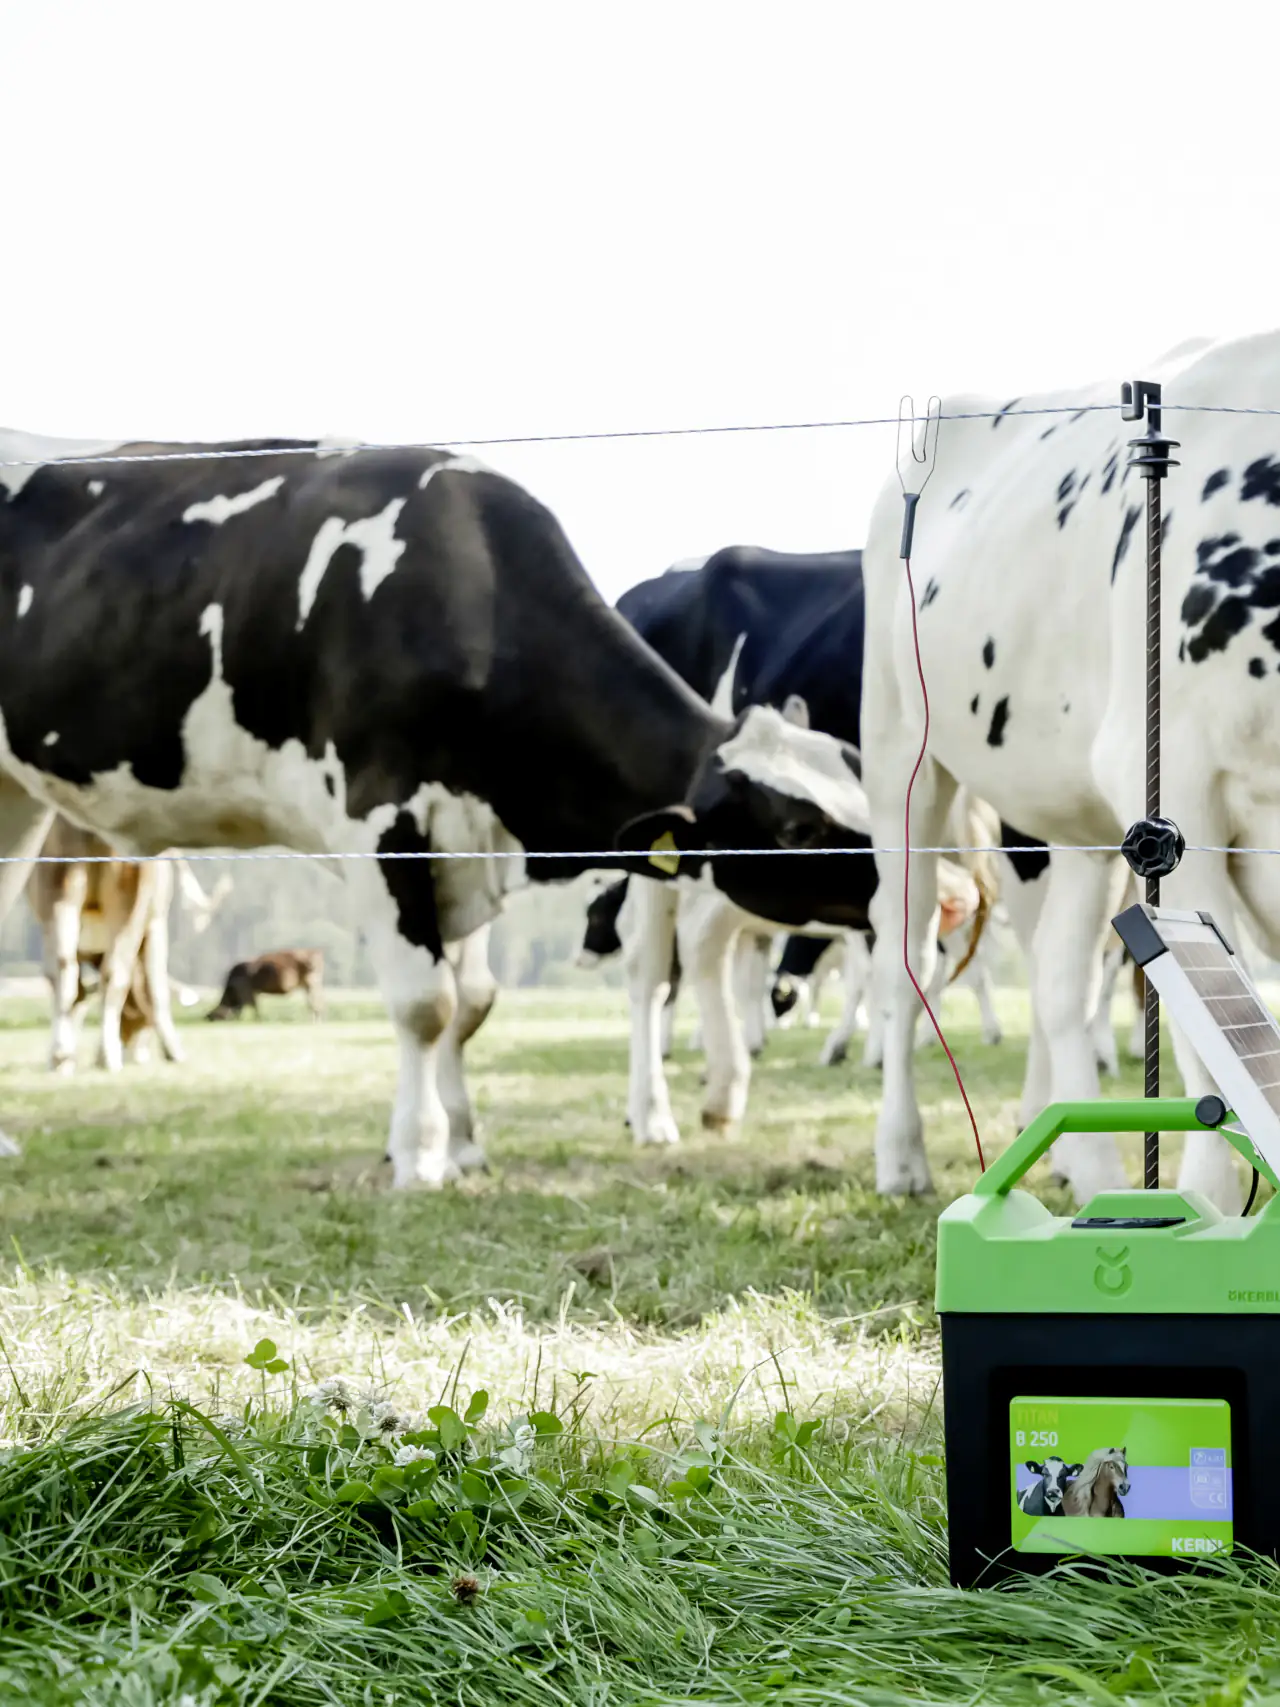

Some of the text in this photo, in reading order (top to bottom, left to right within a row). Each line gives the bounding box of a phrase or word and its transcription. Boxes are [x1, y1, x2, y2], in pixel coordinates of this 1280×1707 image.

[1015, 1409, 1059, 1425] TITAN
[1015, 1430, 1059, 1447] B 250
